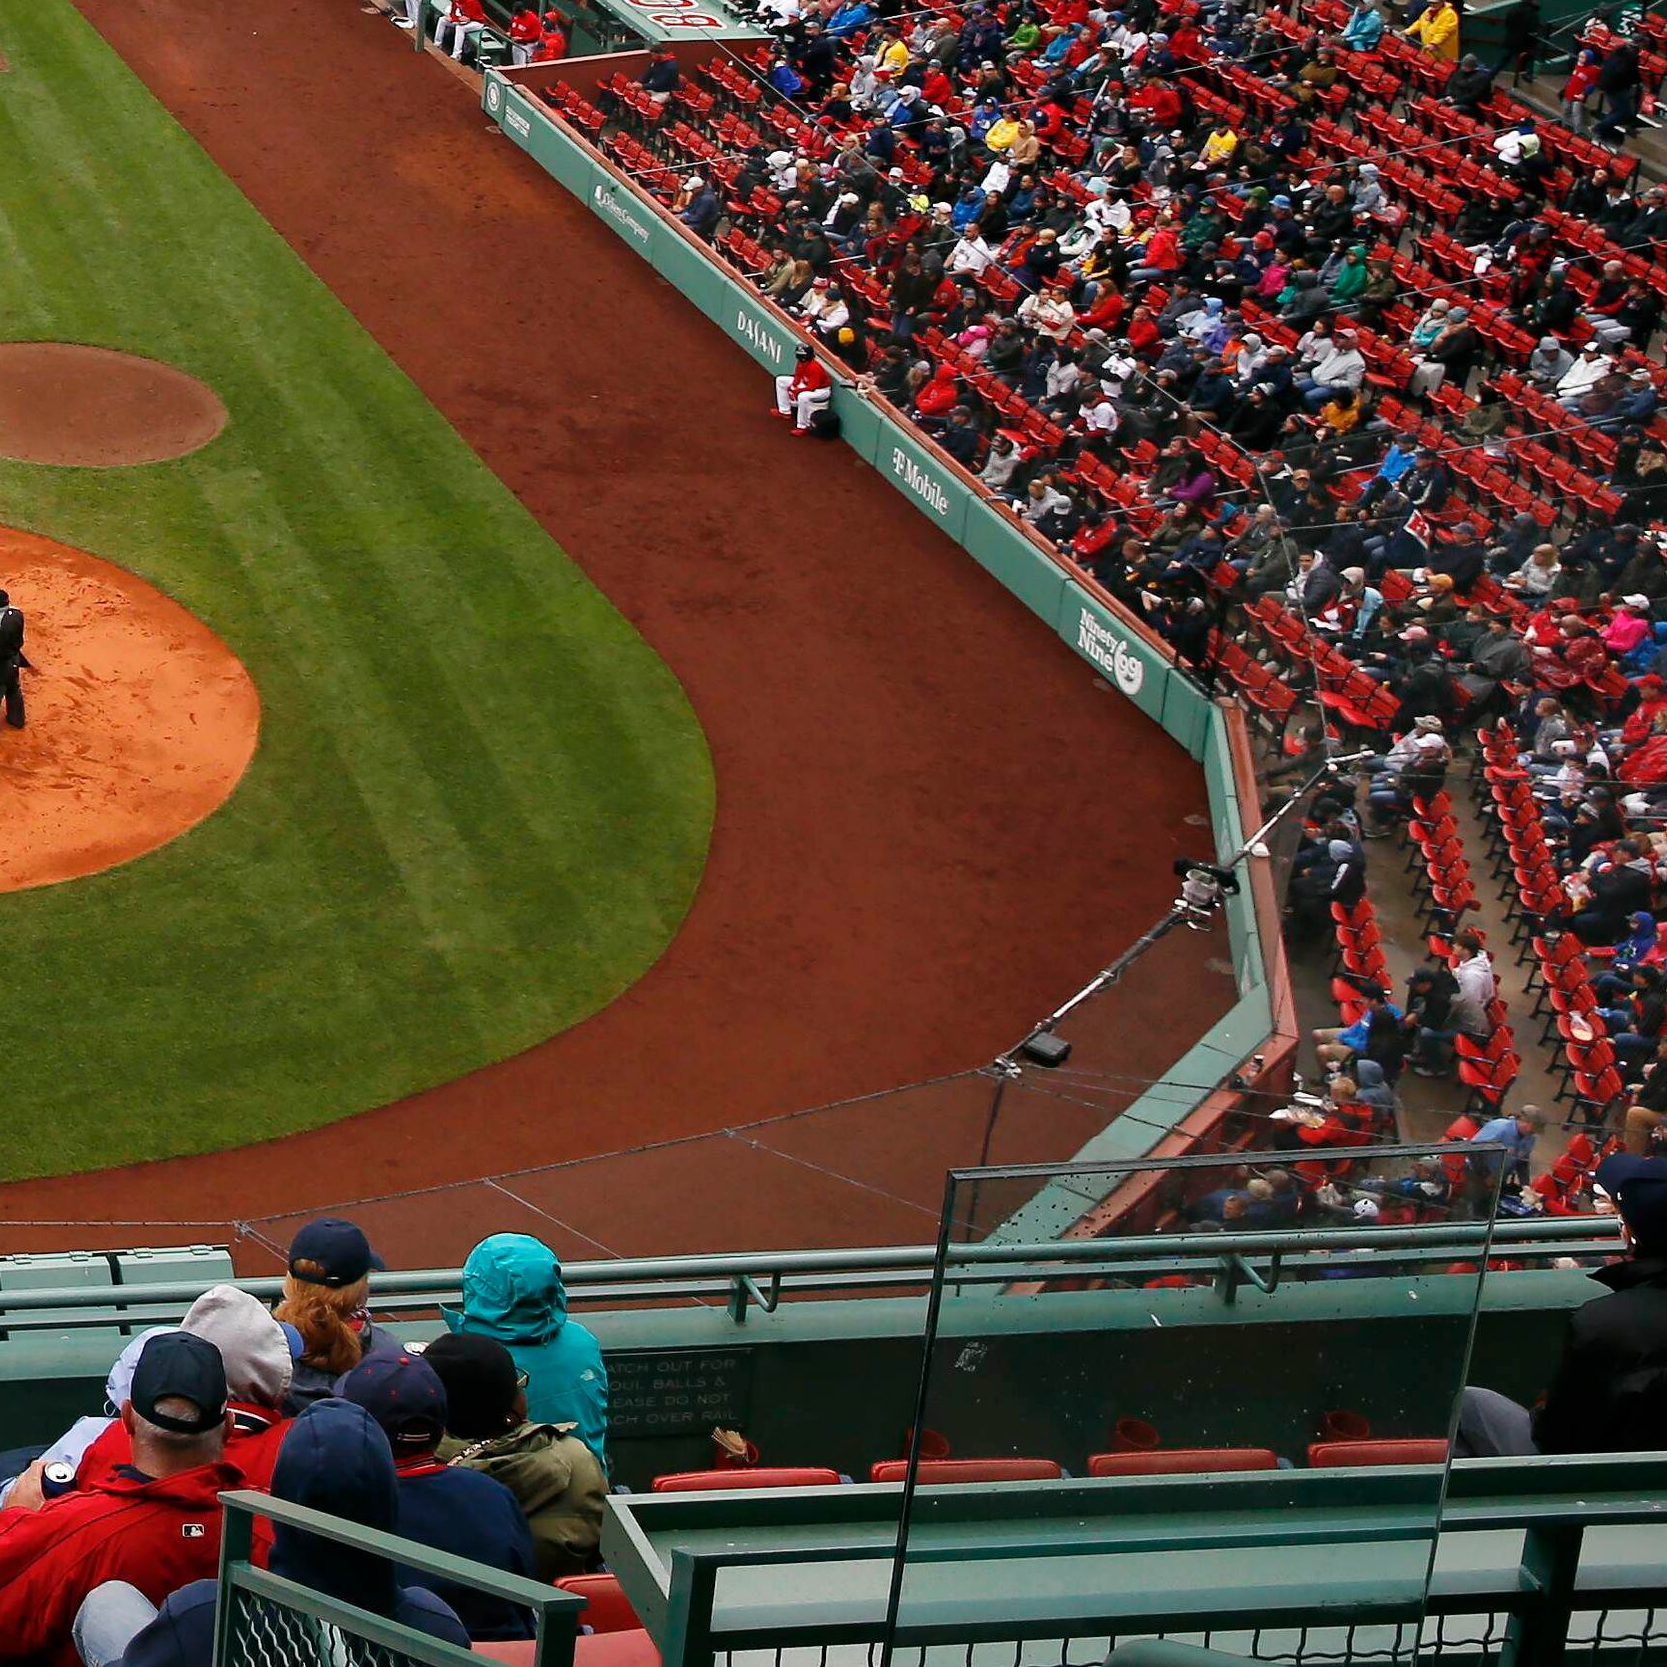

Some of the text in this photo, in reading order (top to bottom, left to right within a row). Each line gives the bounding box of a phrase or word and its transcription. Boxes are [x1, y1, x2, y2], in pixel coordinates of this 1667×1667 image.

[737, 311, 782, 364] DASANI
[1077, 626, 1113, 672] Nine
[1080, 607, 1117, 653] Ninety
